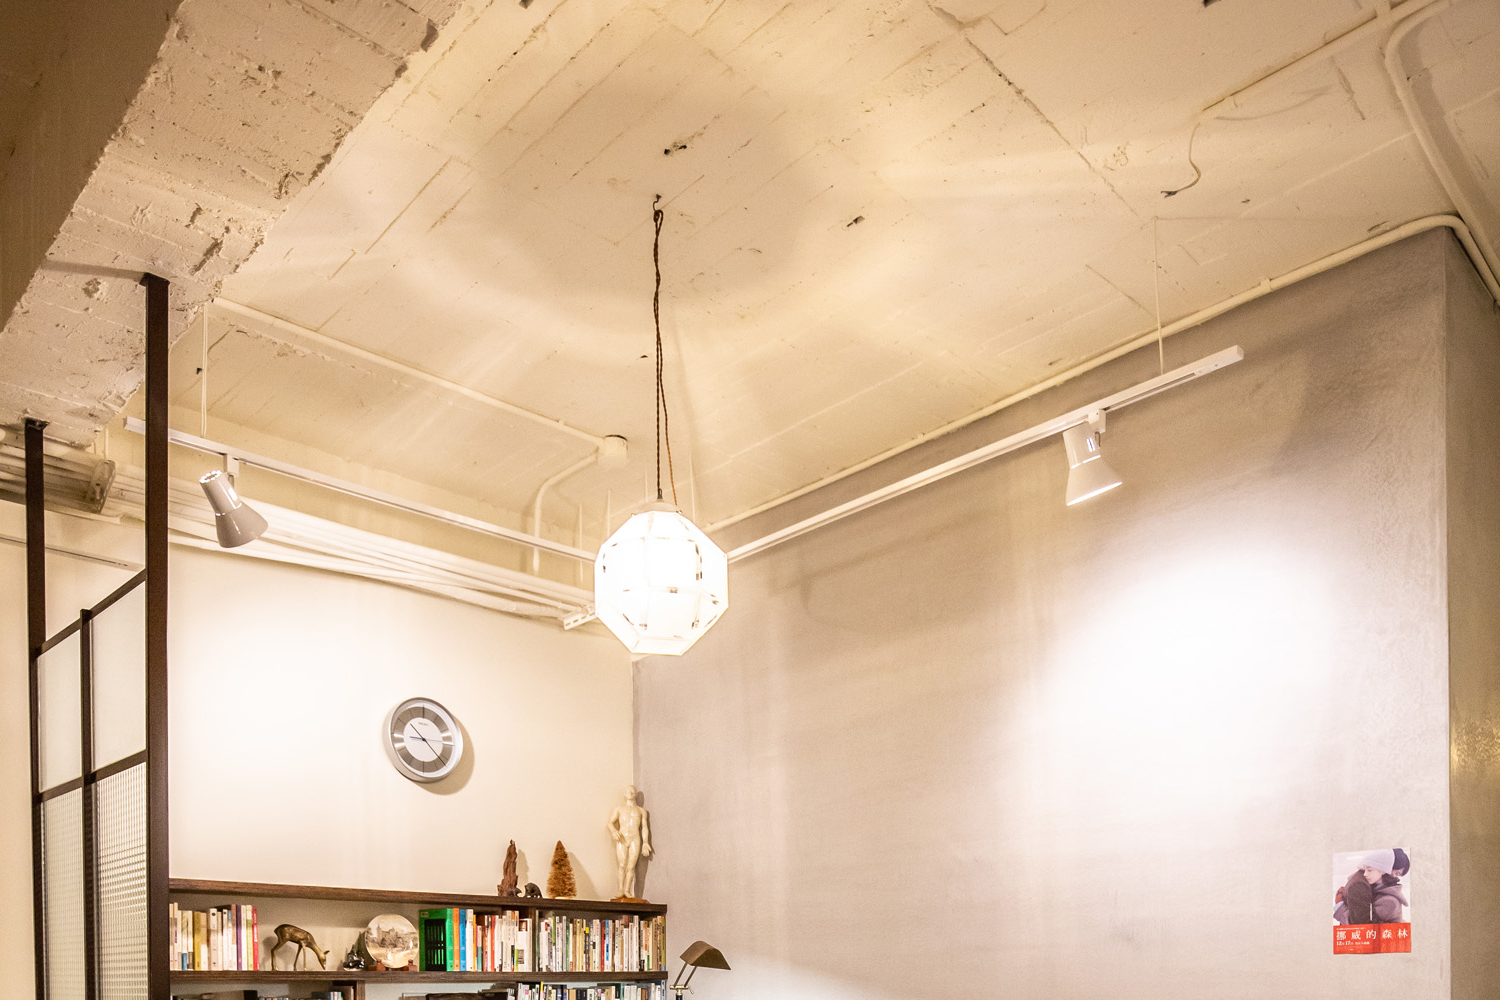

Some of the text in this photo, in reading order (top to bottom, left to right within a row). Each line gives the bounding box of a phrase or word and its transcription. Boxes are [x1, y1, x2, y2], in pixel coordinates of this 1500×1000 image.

[1336, 928, 1408, 940] 挪威的森林
